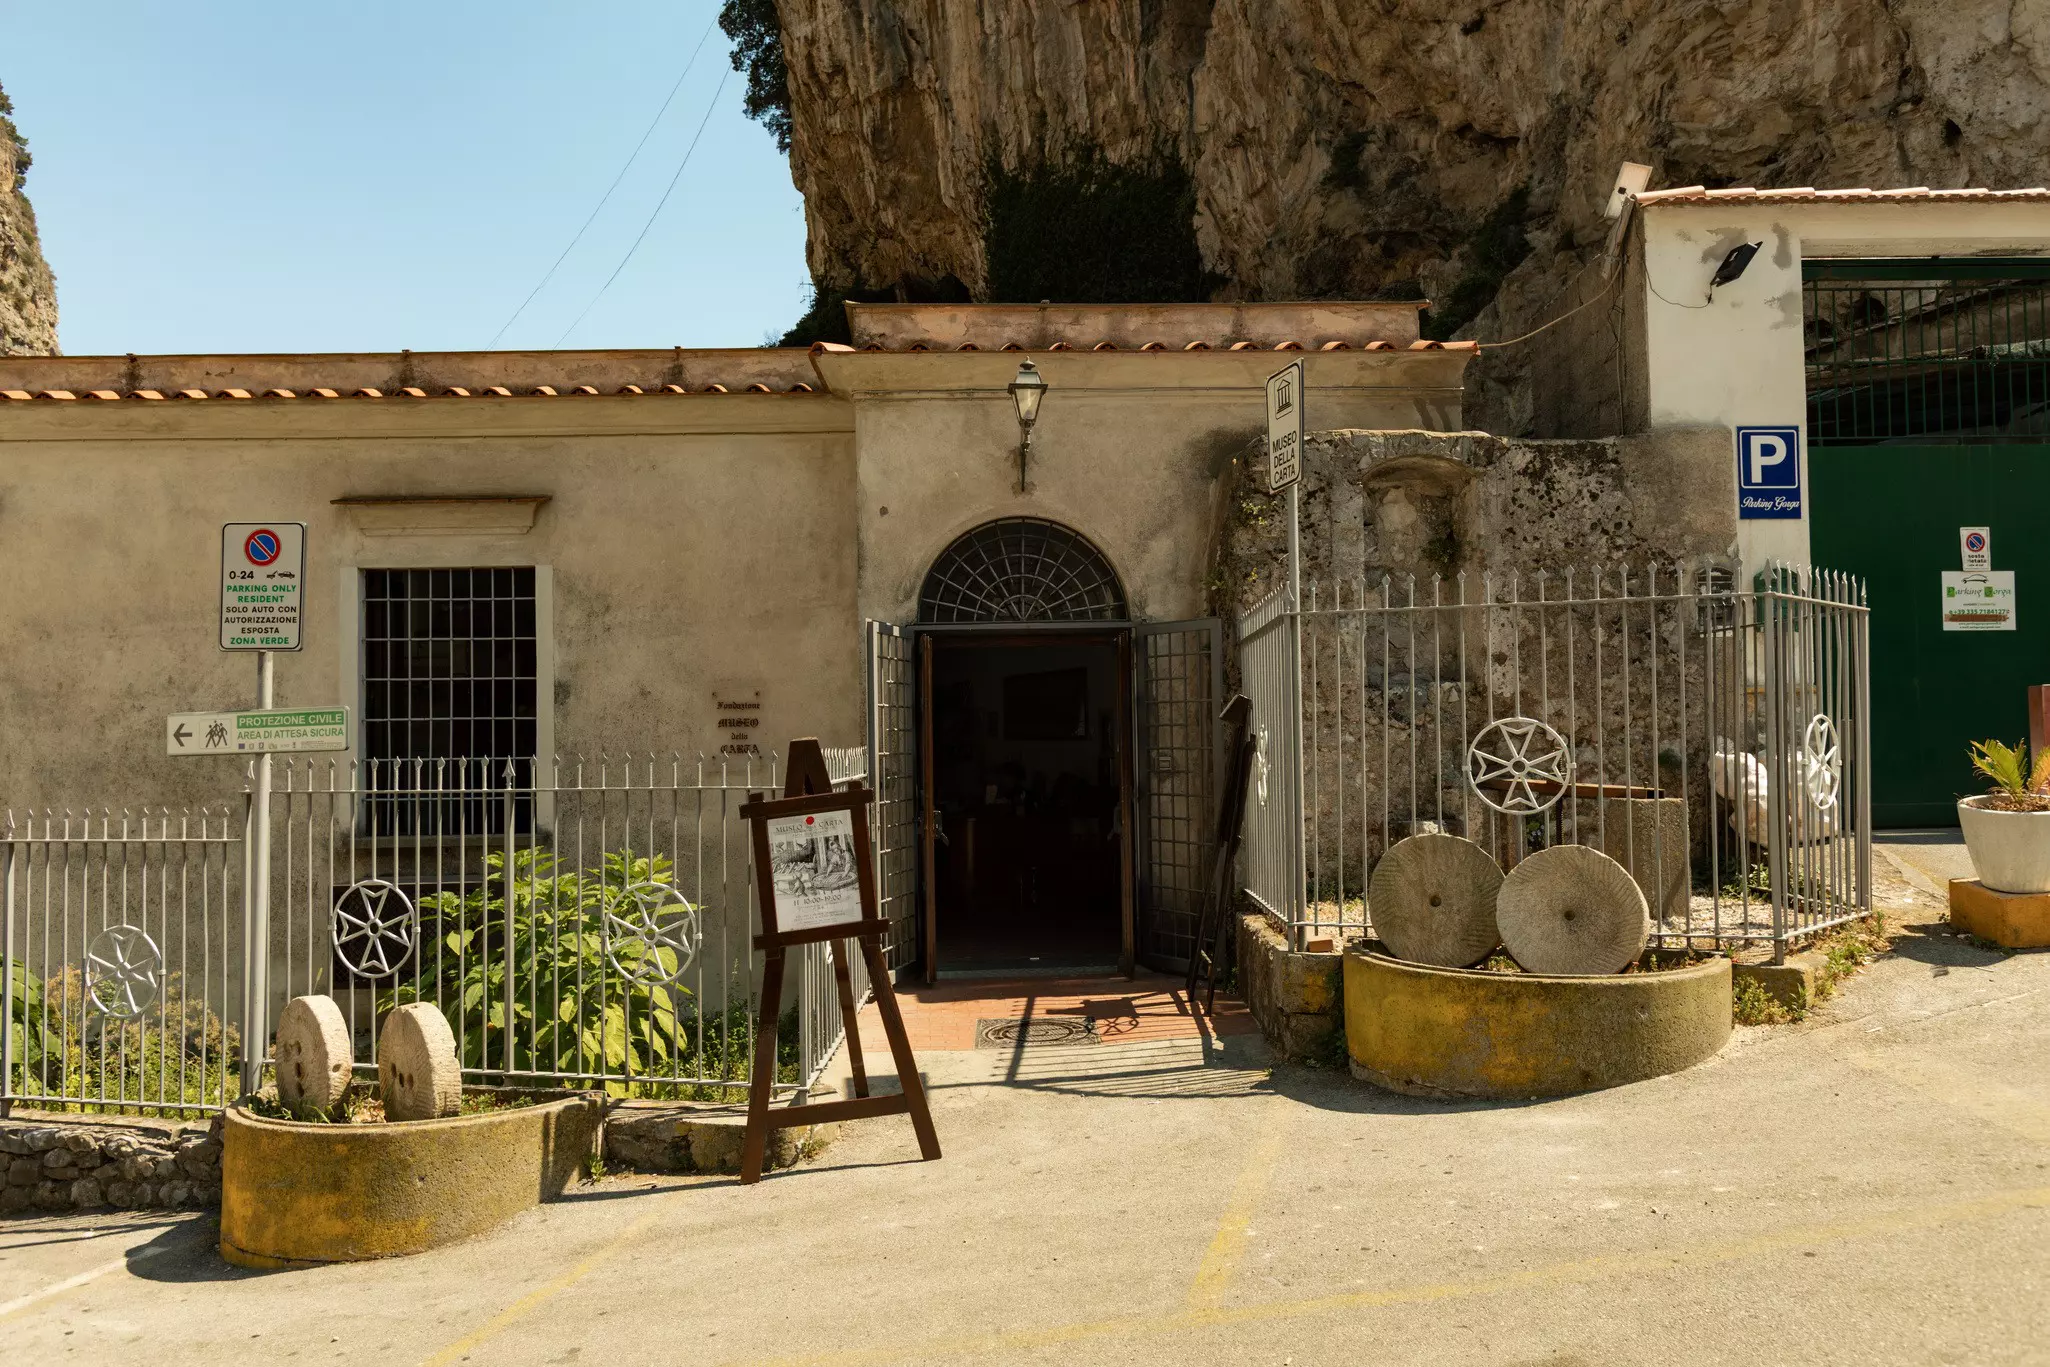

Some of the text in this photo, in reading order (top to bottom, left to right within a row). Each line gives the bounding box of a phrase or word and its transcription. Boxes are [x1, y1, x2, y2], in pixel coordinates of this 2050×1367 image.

[1272, 430, 1297, 453] MUSEO
[1274, 447, 1295, 468] DELLA
[1750, 435, 1787, 484] P
[1274, 464, 1296, 484] CARTA
[1741, 496, 1800, 510] Parking Gorga
[229, 571, 254, 579] 0-24
[1946, 586, 2011, 598] Parking Gorga
[237, 595, 285, 603] RESIDENT
[224, 616, 297, 624] AUTORIZZAZIONE
[230, 637, 256, 645] ZONA
[716, 701, 760, 710] Fondazione
[239, 713, 342, 726] PROTEZIONE CIVILE
[718, 718, 759, 728] MUSEO
[237, 728, 344, 740] AREA DI ATTESA SICURA
[731, 732, 748, 740] della
[720, 744, 759, 754] CARTA
[818, 819, 844, 828] CARTA
